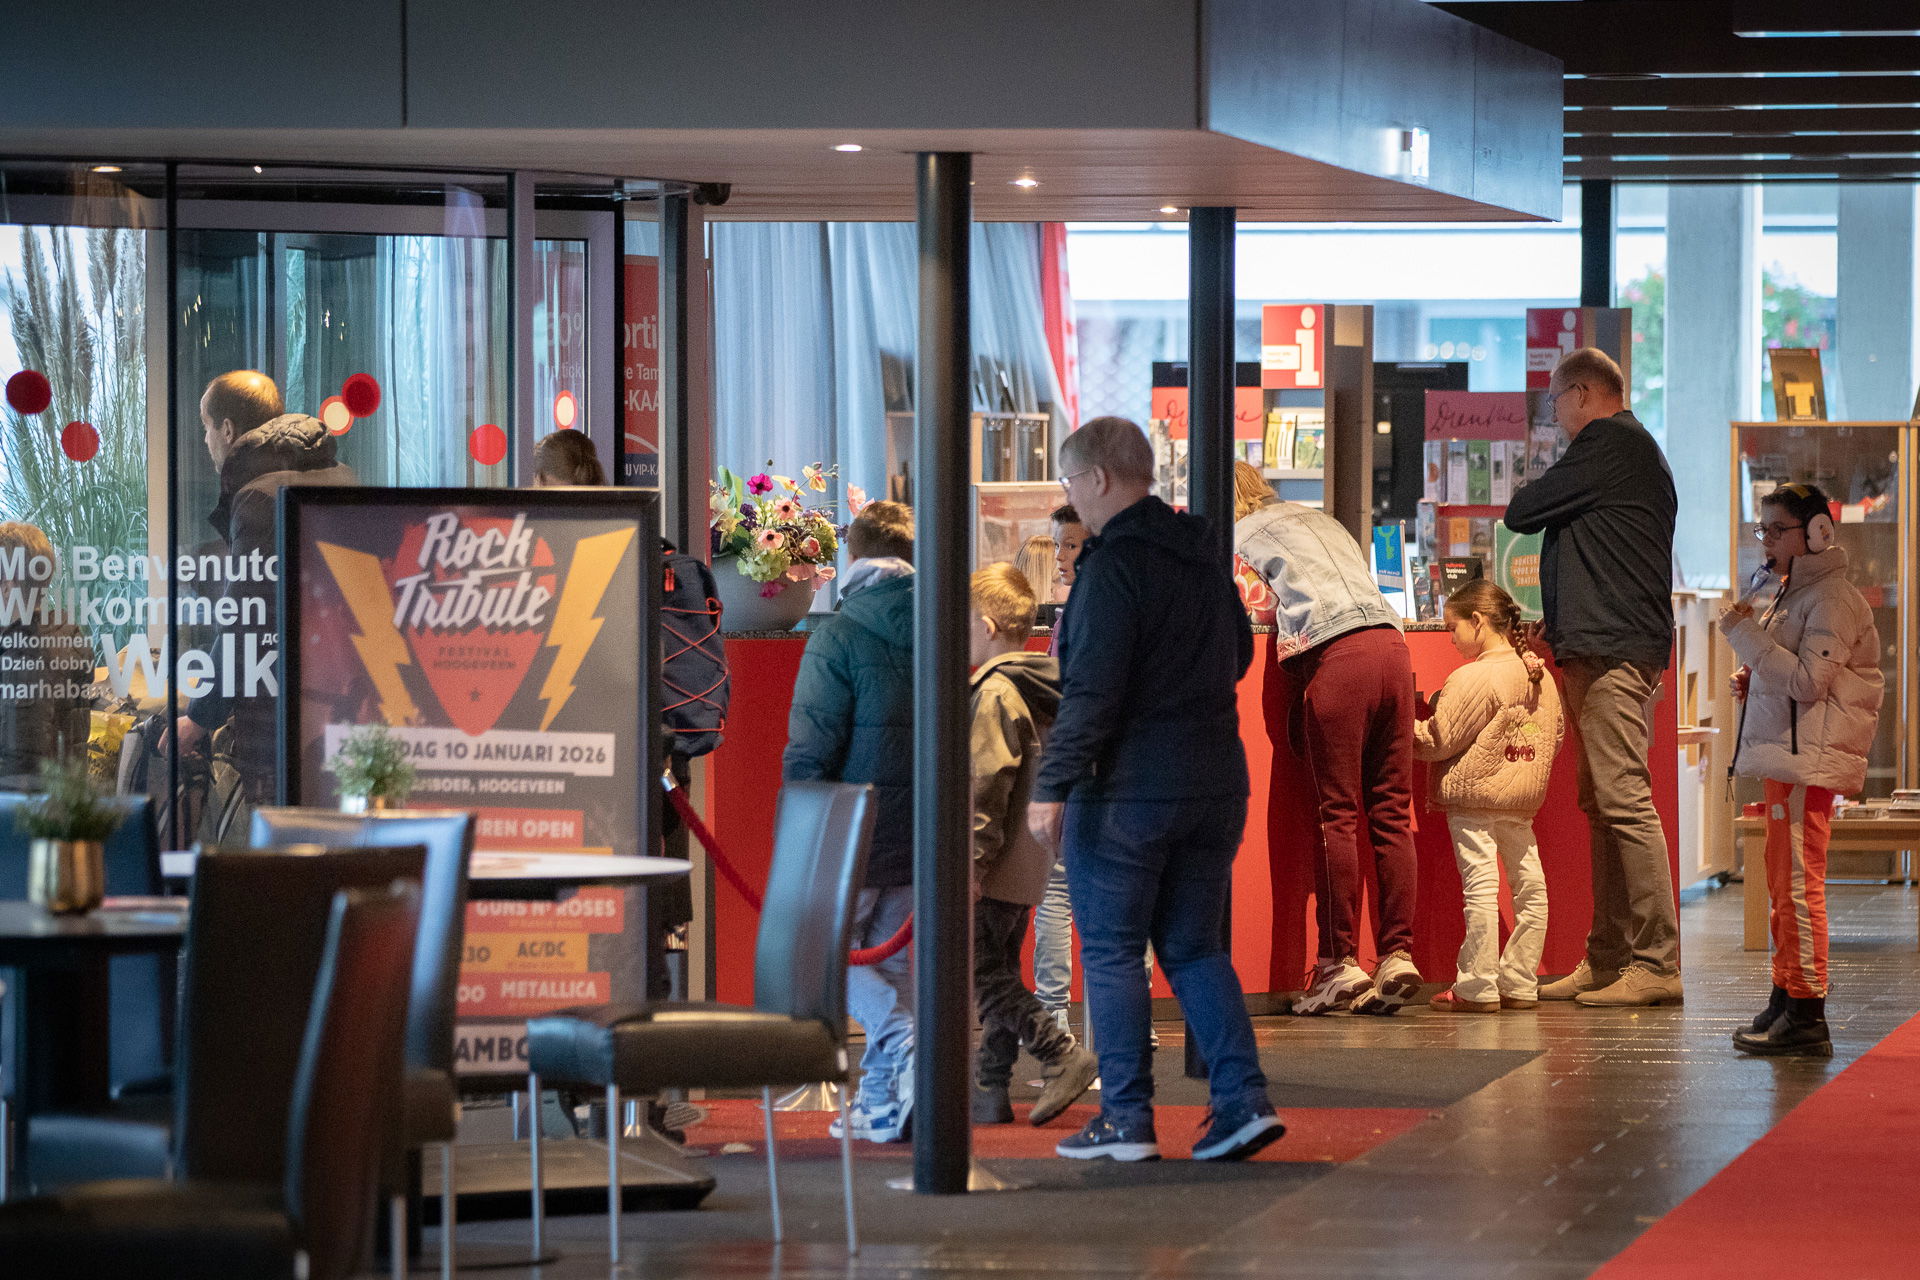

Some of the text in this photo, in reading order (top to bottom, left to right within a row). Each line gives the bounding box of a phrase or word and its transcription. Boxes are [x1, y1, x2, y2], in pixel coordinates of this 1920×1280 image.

[416, 512, 535, 569] Rock
[0, 587, 267, 626] Willkommen
[392, 567, 552, 628] Tribute
[0, 632, 93, 649] elkommen
[2, 656, 94, 673] Dzień dobry
[101, 633, 278, 698] Welk
[0, 679, 92, 699] marhaba
[444, 742, 469, 759] 10
[473, 743, 552, 762] JANUARI
[559, 746, 606, 764] 2026
[479, 779, 566, 795] HOOGEVEEN
[522, 820, 575, 839] OPEN
[476, 901, 527, 917] GUNS
[517, 941, 567, 958] AC/DC
[501, 980, 598, 999] METALLICA
